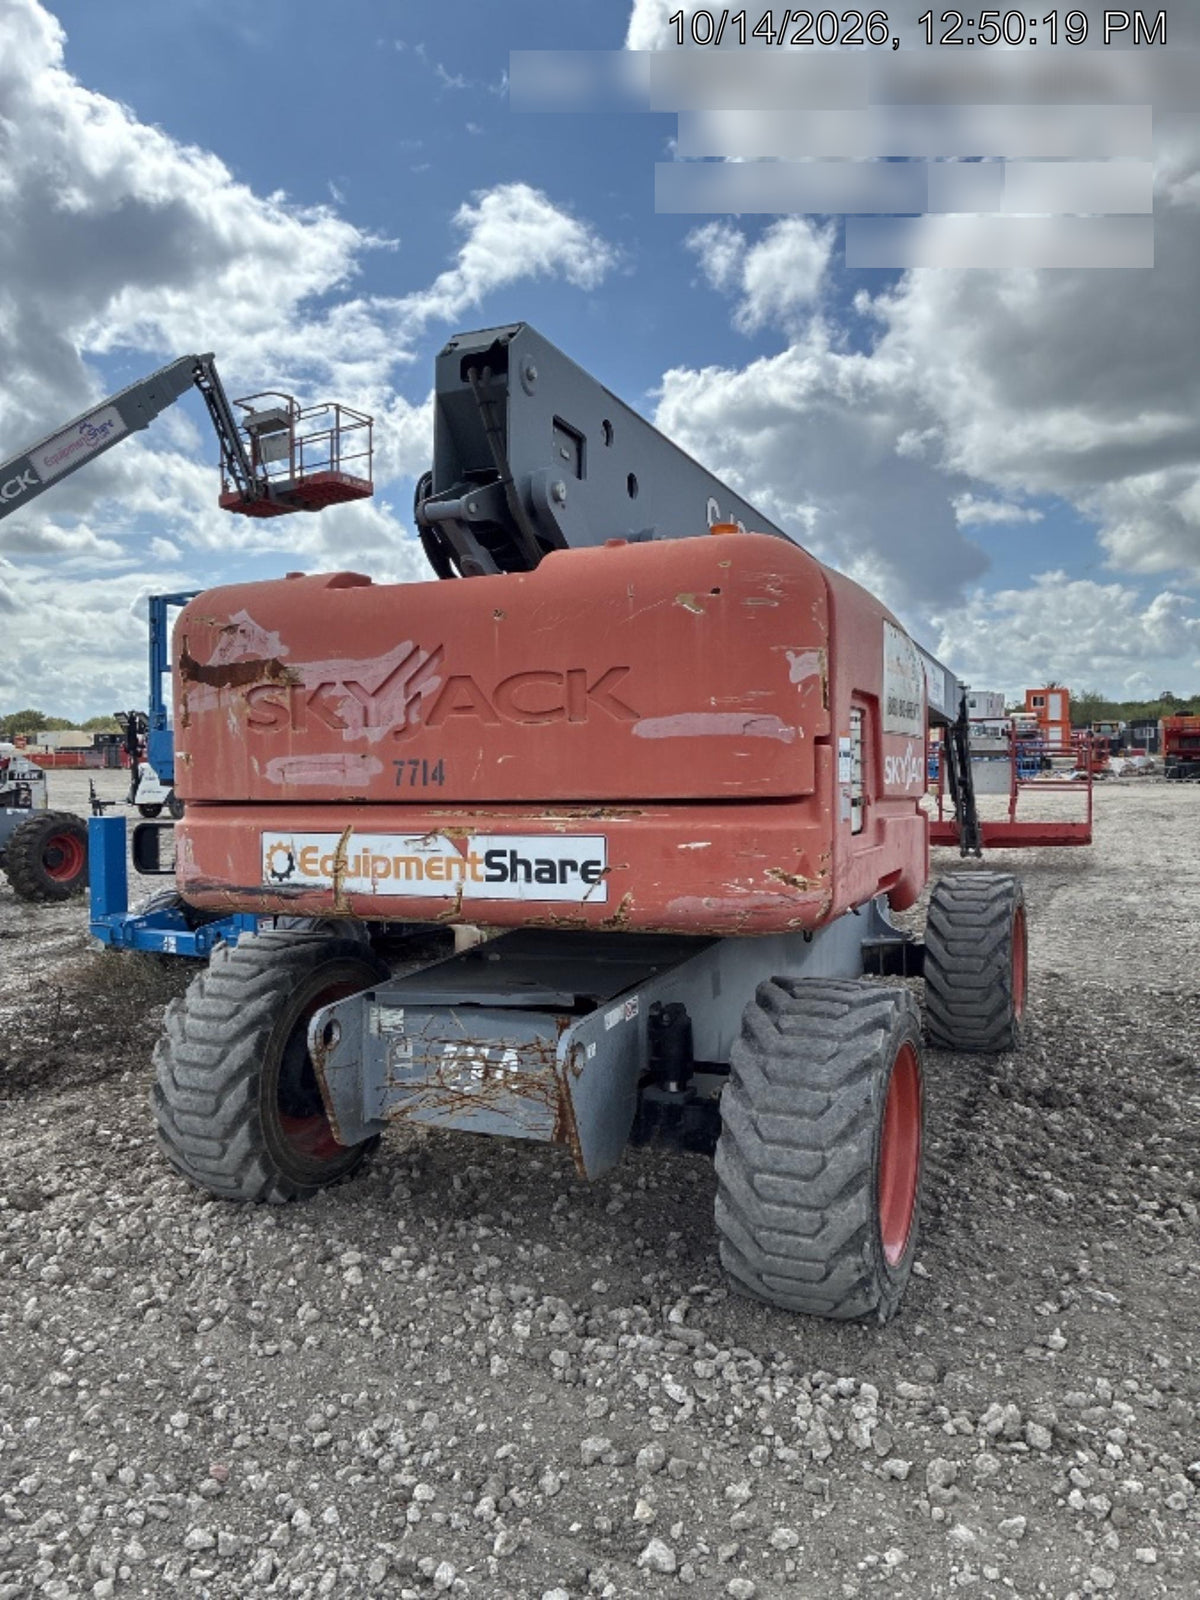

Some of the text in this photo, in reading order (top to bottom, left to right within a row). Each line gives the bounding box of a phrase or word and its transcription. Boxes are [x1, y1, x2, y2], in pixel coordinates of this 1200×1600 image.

[0, 468, 40, 504] CK
[246, 643, 640, 741] SKYJACK
[393, 758, 445, 786] 7714
[883, 742, 924, 791] SKYJAC
[299, 846, 603, 887] EquipmentShare
